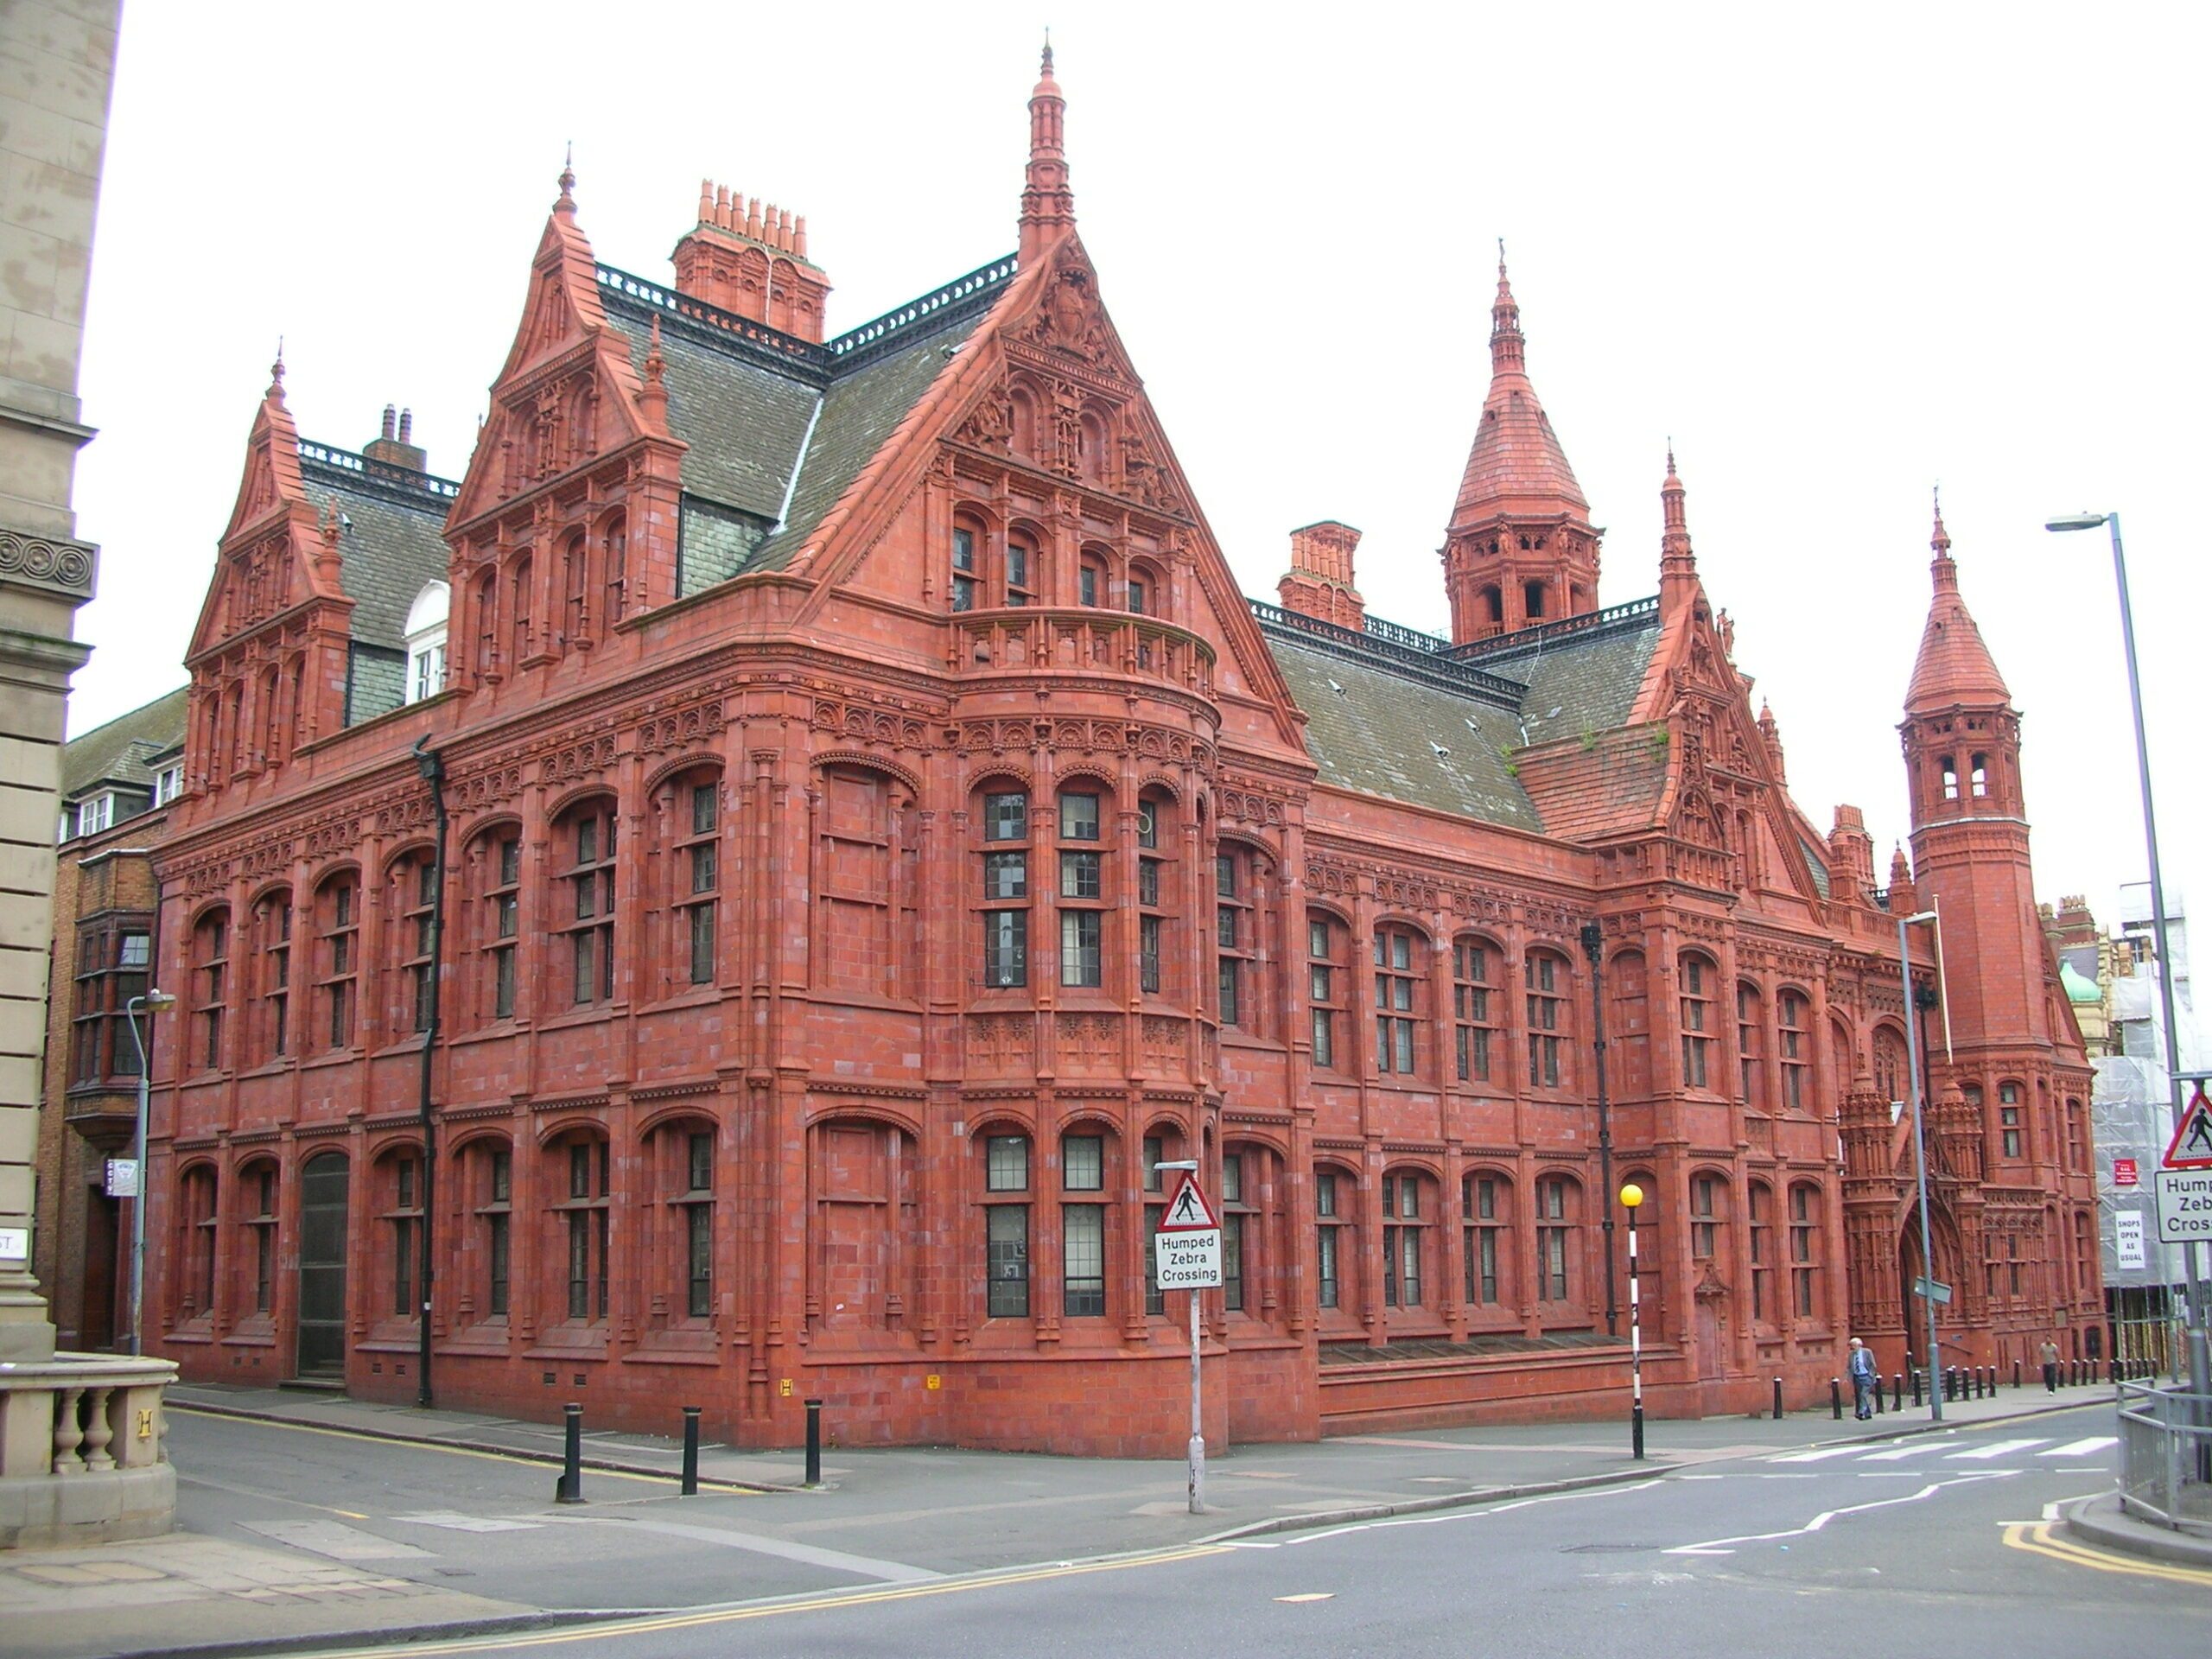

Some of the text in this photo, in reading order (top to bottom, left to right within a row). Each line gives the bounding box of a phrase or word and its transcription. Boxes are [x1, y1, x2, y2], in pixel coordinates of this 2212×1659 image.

[2167, 1217, 2212, 1232] Cros
[1161, 1235, 1214, 1250] Humped
[1170, 1252, 1207, 1265] Zebra
[2120, 1253, 2142, 1262] USUAL
[1162, 1268, 1217, 1282] Crossing
[138, 1409, 152, 1434] H
